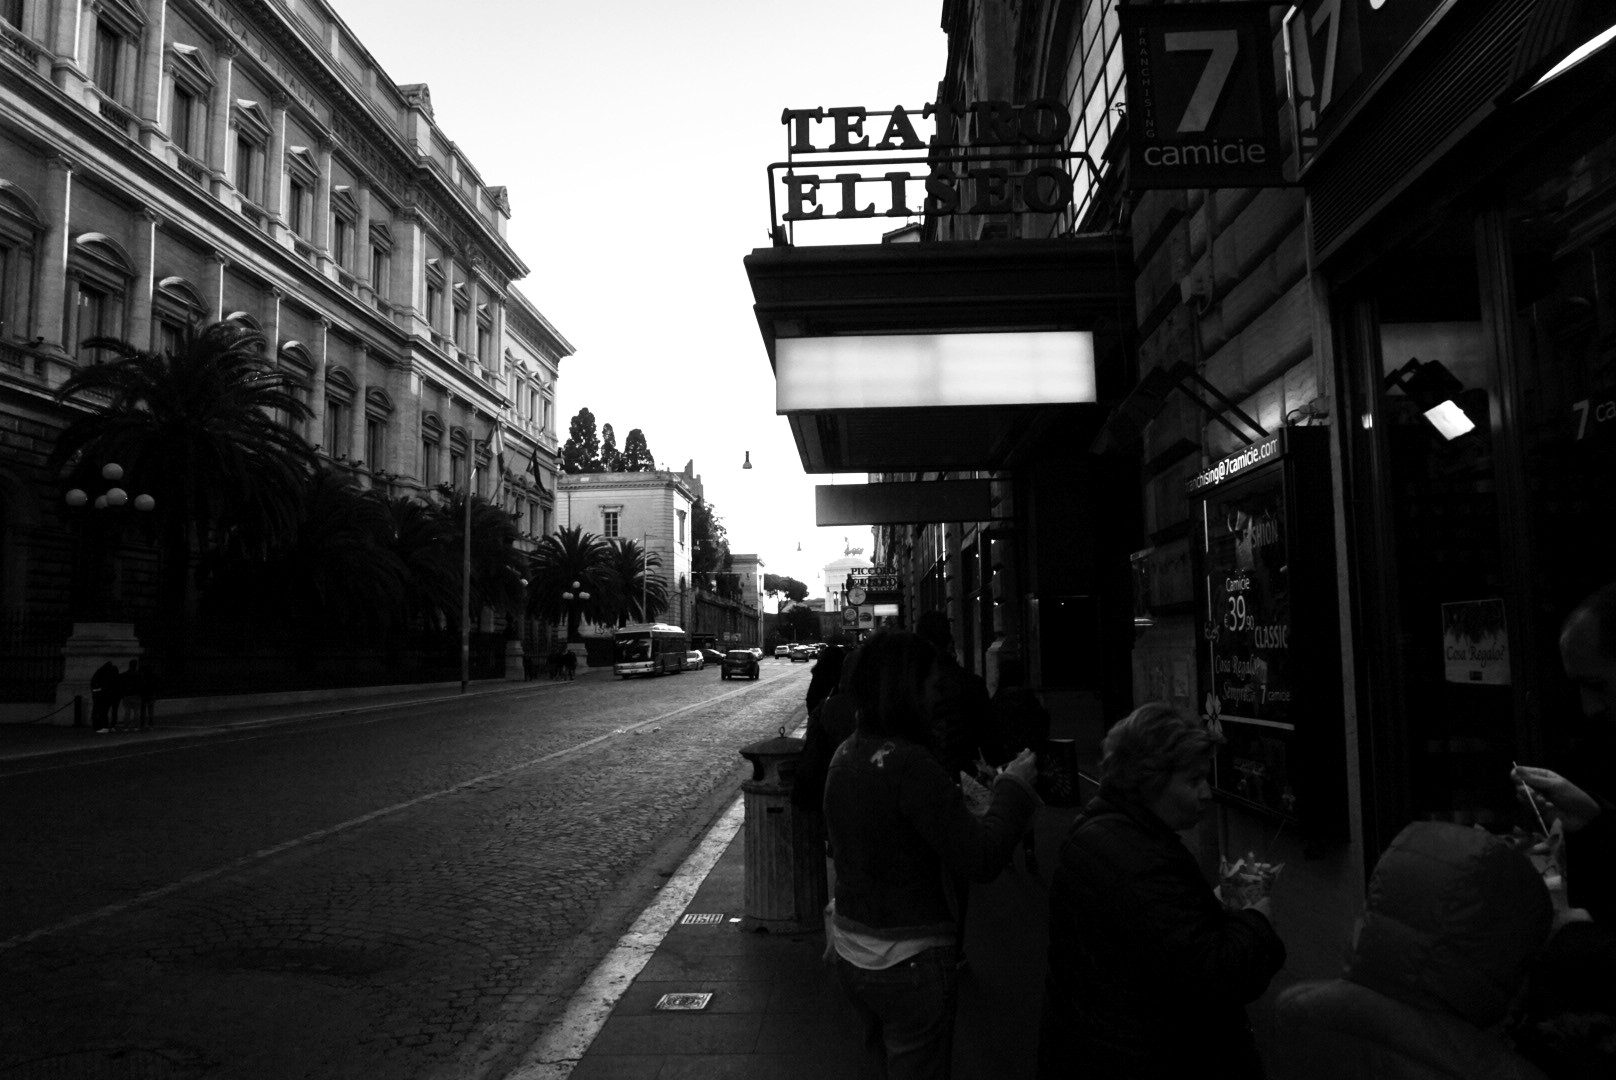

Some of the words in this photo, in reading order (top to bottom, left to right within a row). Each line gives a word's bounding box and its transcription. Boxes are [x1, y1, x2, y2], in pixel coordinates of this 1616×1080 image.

[1137, 26, 1155, 138] FRANCHISING
[1164, 29, 1239, 133] 7
[781, 98, 1072, 153] TEATRO
[1144, 138, 1267, 166] camicie
[782, 165, 1074, 221] ELISEO
[1572, 399, 1590, 441] 7
[1254, 624, 1289, 649] CLASSIC
